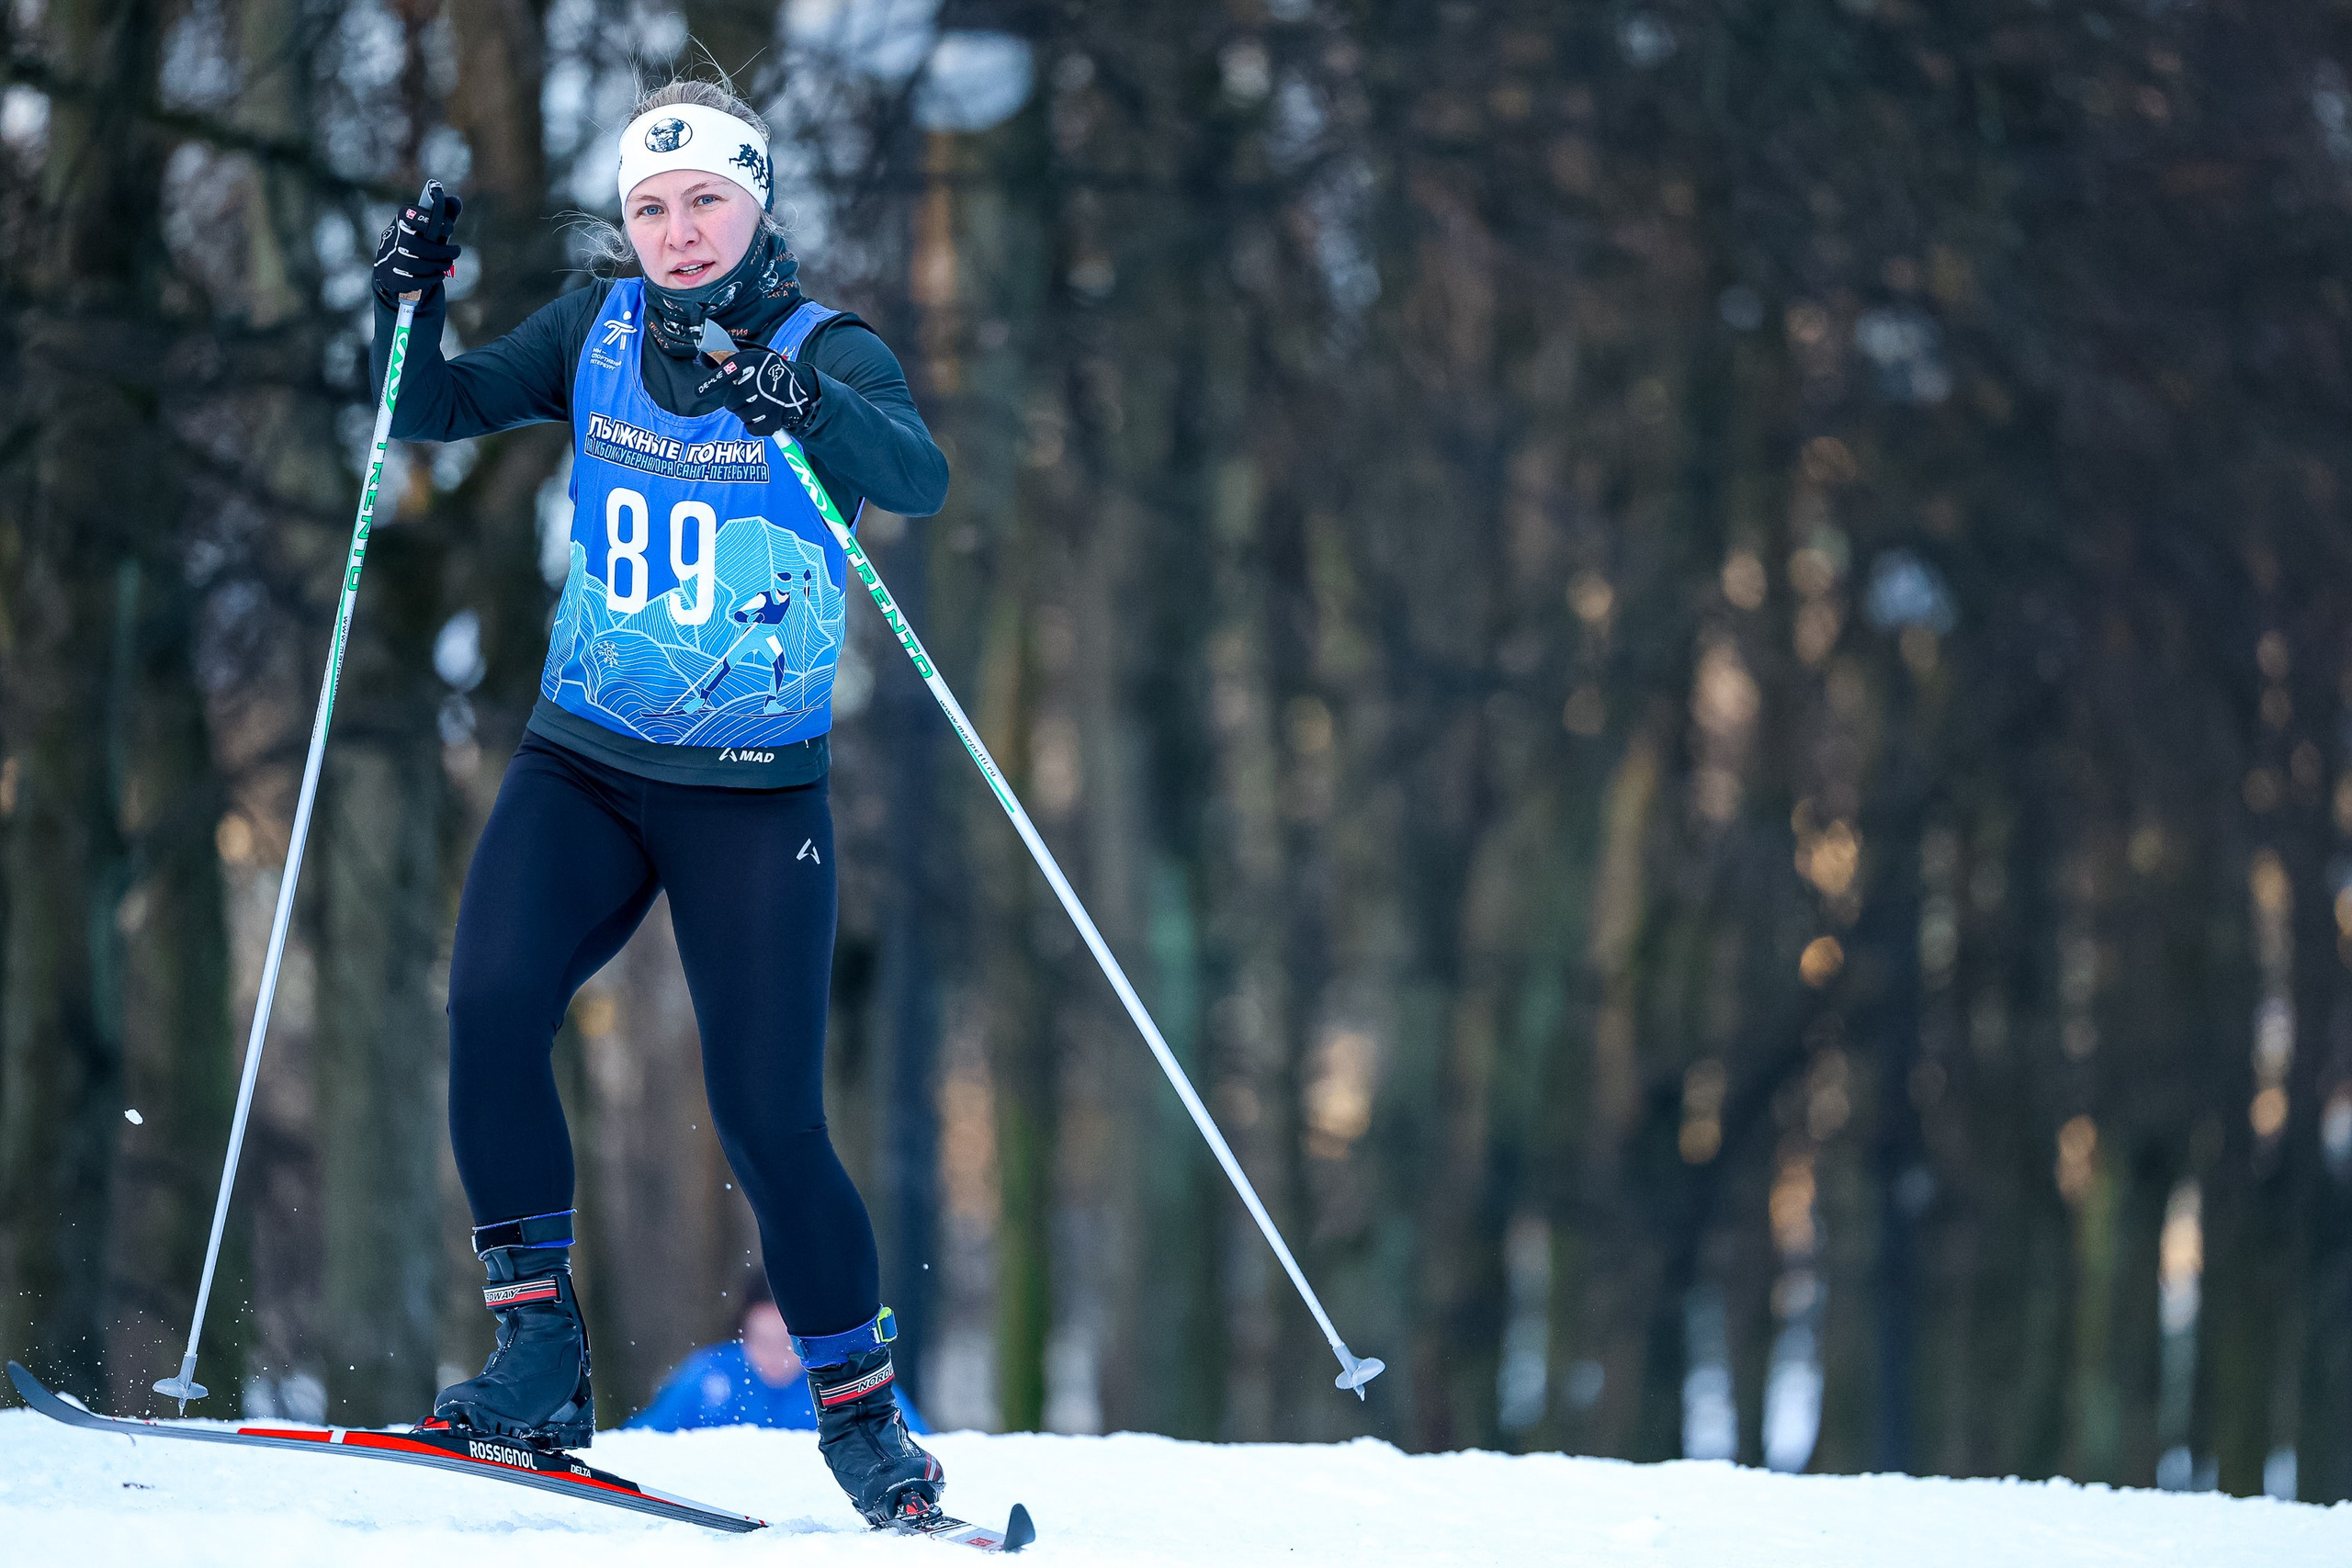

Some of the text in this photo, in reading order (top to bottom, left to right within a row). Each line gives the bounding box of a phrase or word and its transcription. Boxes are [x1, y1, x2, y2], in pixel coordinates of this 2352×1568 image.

[589, 414, 762, 464] ЛЫЖНЫЕ ГОНКИ
[347, 443, 388, 592] TRENTO
[605, 487, 717, 626] 89
[844, 536, 933, 680] TRENTO
[939, 699, 997, 778] www.marpetti.ru
[469, 1439, 537, 1471] ROSSIGNOL
[570, 1463, 592, 1478] DELTA
